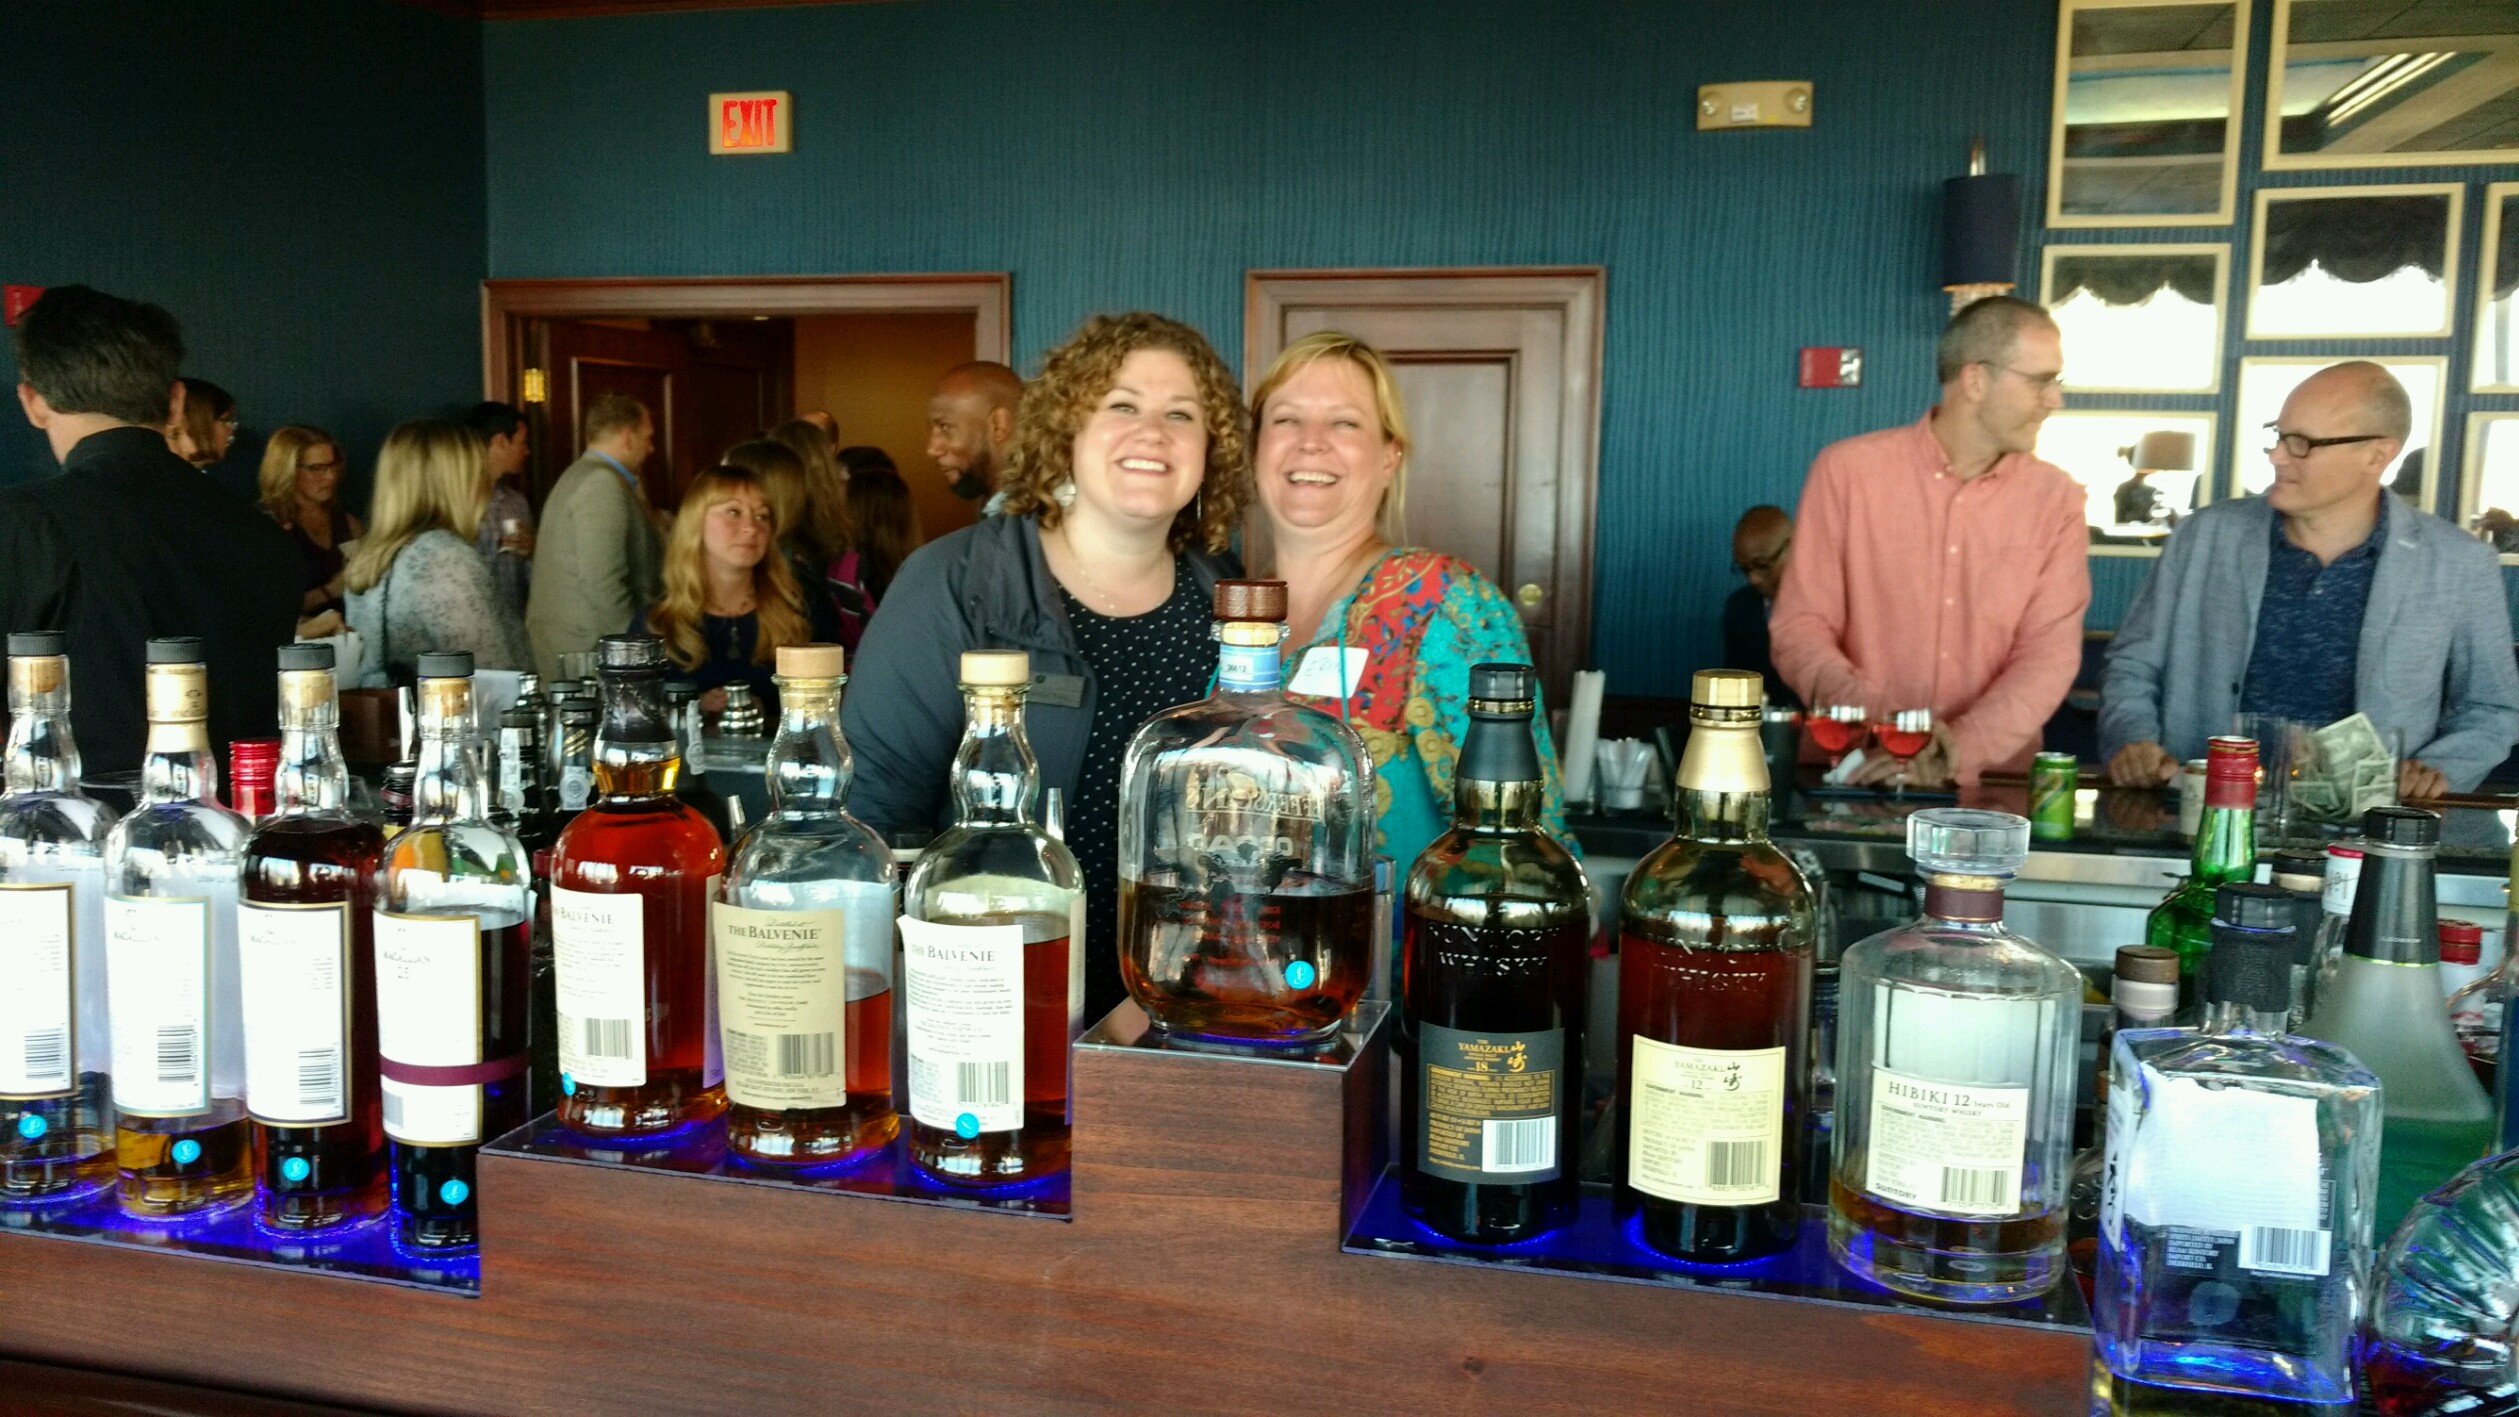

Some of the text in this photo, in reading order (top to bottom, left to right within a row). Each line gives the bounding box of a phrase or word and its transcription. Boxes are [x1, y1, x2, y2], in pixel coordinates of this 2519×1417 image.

[722, 99, 778, 147] EXIT
[728, 925, 819, 940] THE BALVENIE
[928, 945, 996, 961] BALVENIE
[1458, 1043, 1511, 1053] YAMAZAKI
[1475, 1061, 1489, 1072] 18
[1691, 1080, 1703, 1090] 12
[1888, 1081, 1948, 1105] HIBIKI
[1954, 1094, 1971, 1107] 12
